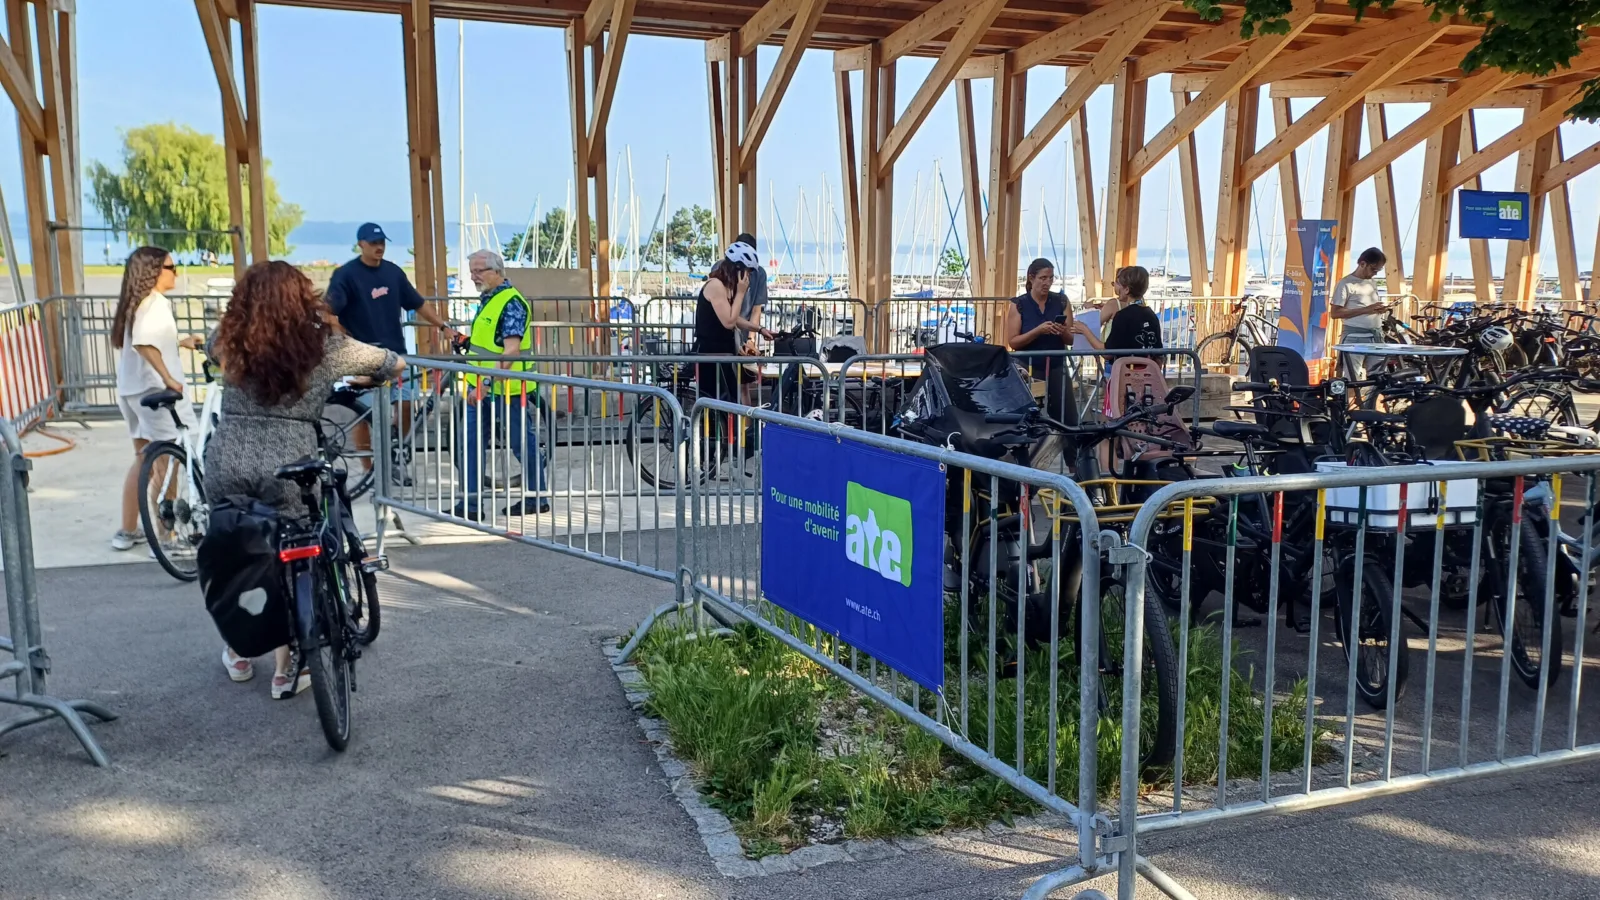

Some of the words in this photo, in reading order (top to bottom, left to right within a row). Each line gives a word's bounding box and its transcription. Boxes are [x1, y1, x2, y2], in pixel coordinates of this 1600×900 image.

[1499, 205, 1519, 220] ate
[771, 486, 787, 505] Pour
[788, 495, 803, 510] une
[804, 500, 840, 522] mobilité
[804, 517, 840, 542] d'avenir
[845, 508, 902, 583] ate
[845, 596, 881, 622] www.ate.ch
